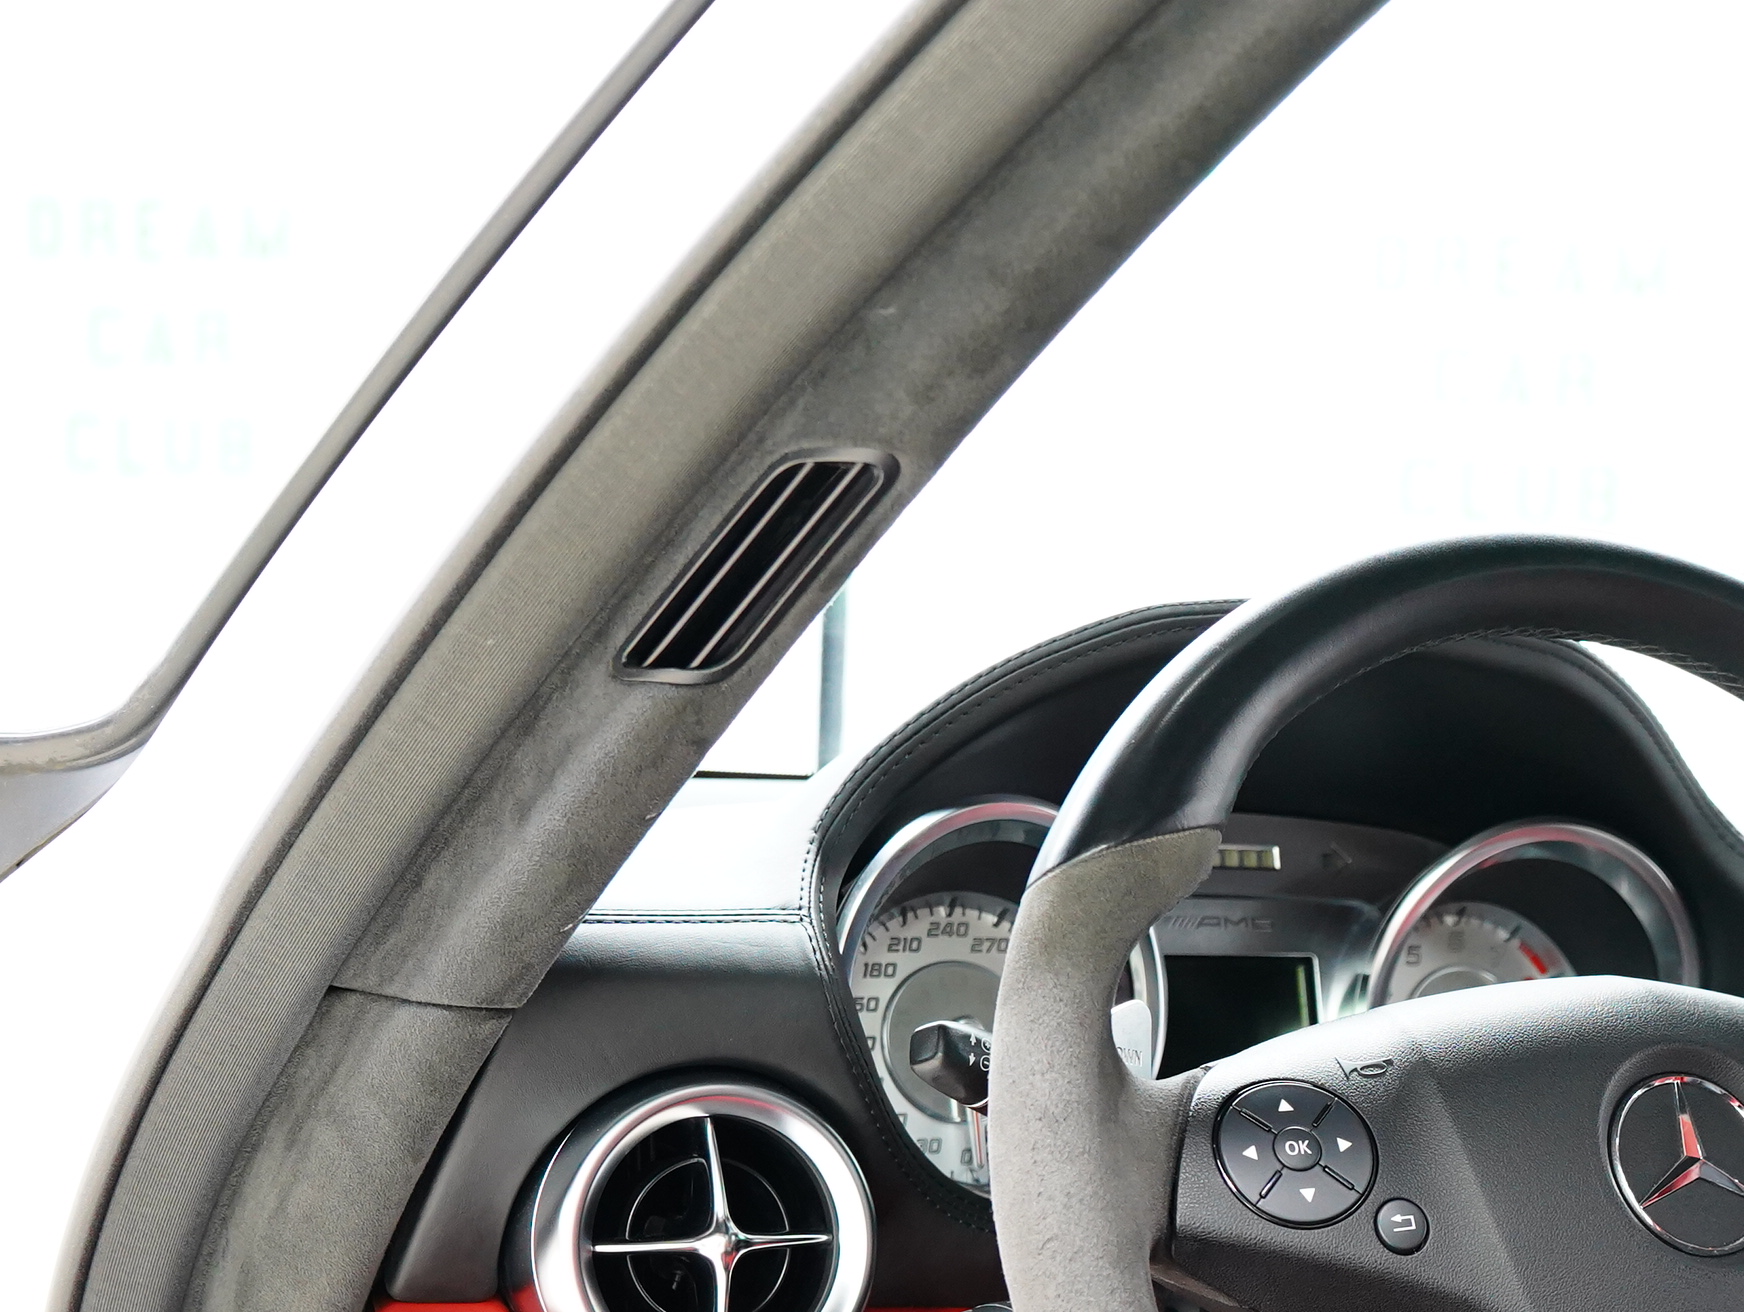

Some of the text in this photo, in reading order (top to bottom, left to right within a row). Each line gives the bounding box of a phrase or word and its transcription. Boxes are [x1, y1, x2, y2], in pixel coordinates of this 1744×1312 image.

[27, 194, 292, 265] DREAM
[1375, 234, 1669, 298] DREAM
[86, 305, 232, 368] CAR
[64, 410, 254, 477] CLUB
[1400, 457, 1619, 526] CLUB
[887, 937, 922, 954] 210
[927, 921, 970, 938] 240
[970, 938, 1010, 954] 270
[862, 962, 897, 979] 180
[1284, 1139, 1312, 1156] OK
